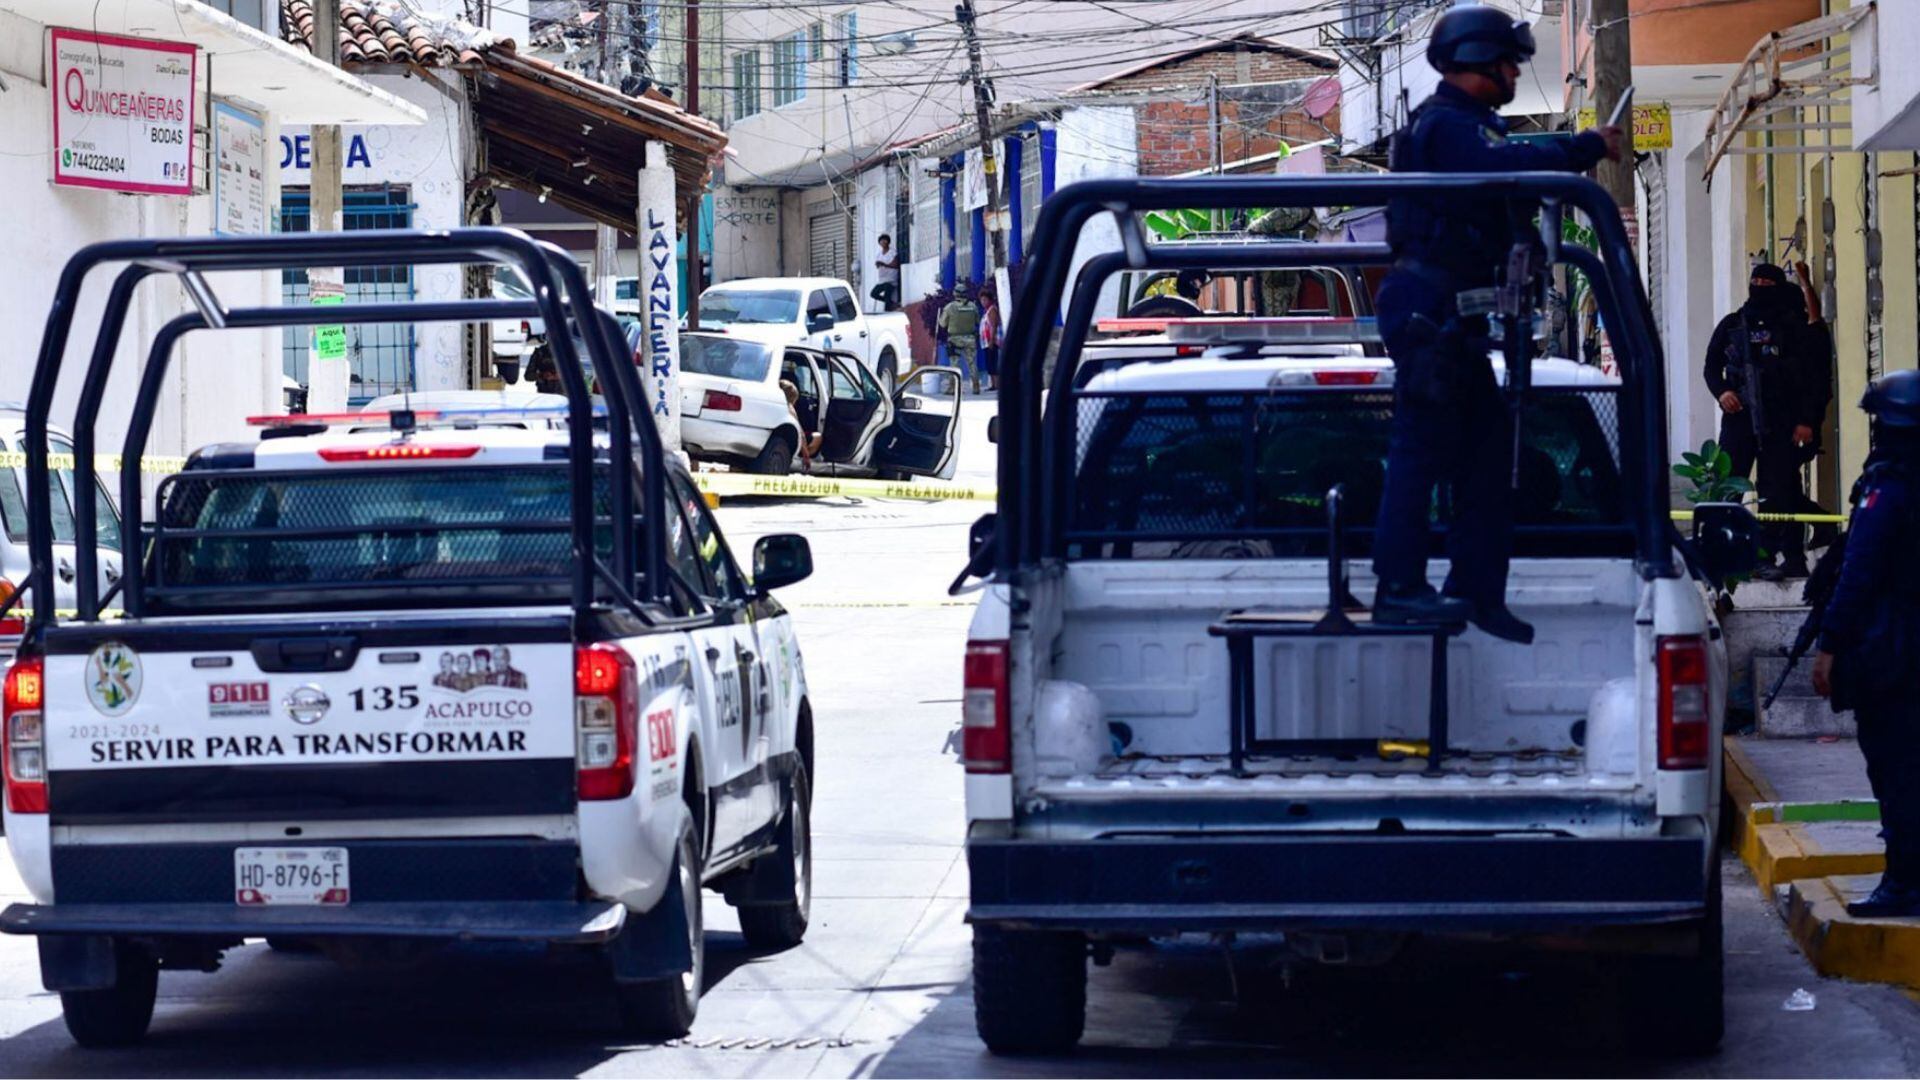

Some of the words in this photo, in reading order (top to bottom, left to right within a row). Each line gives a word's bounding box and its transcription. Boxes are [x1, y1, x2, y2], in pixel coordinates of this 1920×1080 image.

[151, 127, 183, 144] BODAS
[72, 152, 125, 173] 7442229404
[210, 683, 269, 705] 911
[348, 684, 420, 712] 135
[425, 700, 532, 720] ACAPULCO
[69, 723, 162, 739] 2021-2024
[91, 737, 196, 763] SERVIR
[206, 734, 285, 757] PARA
[294, 730, 528, 755] TRANSFORMAR
[240, 863, 343, 888] HD-8796-F
